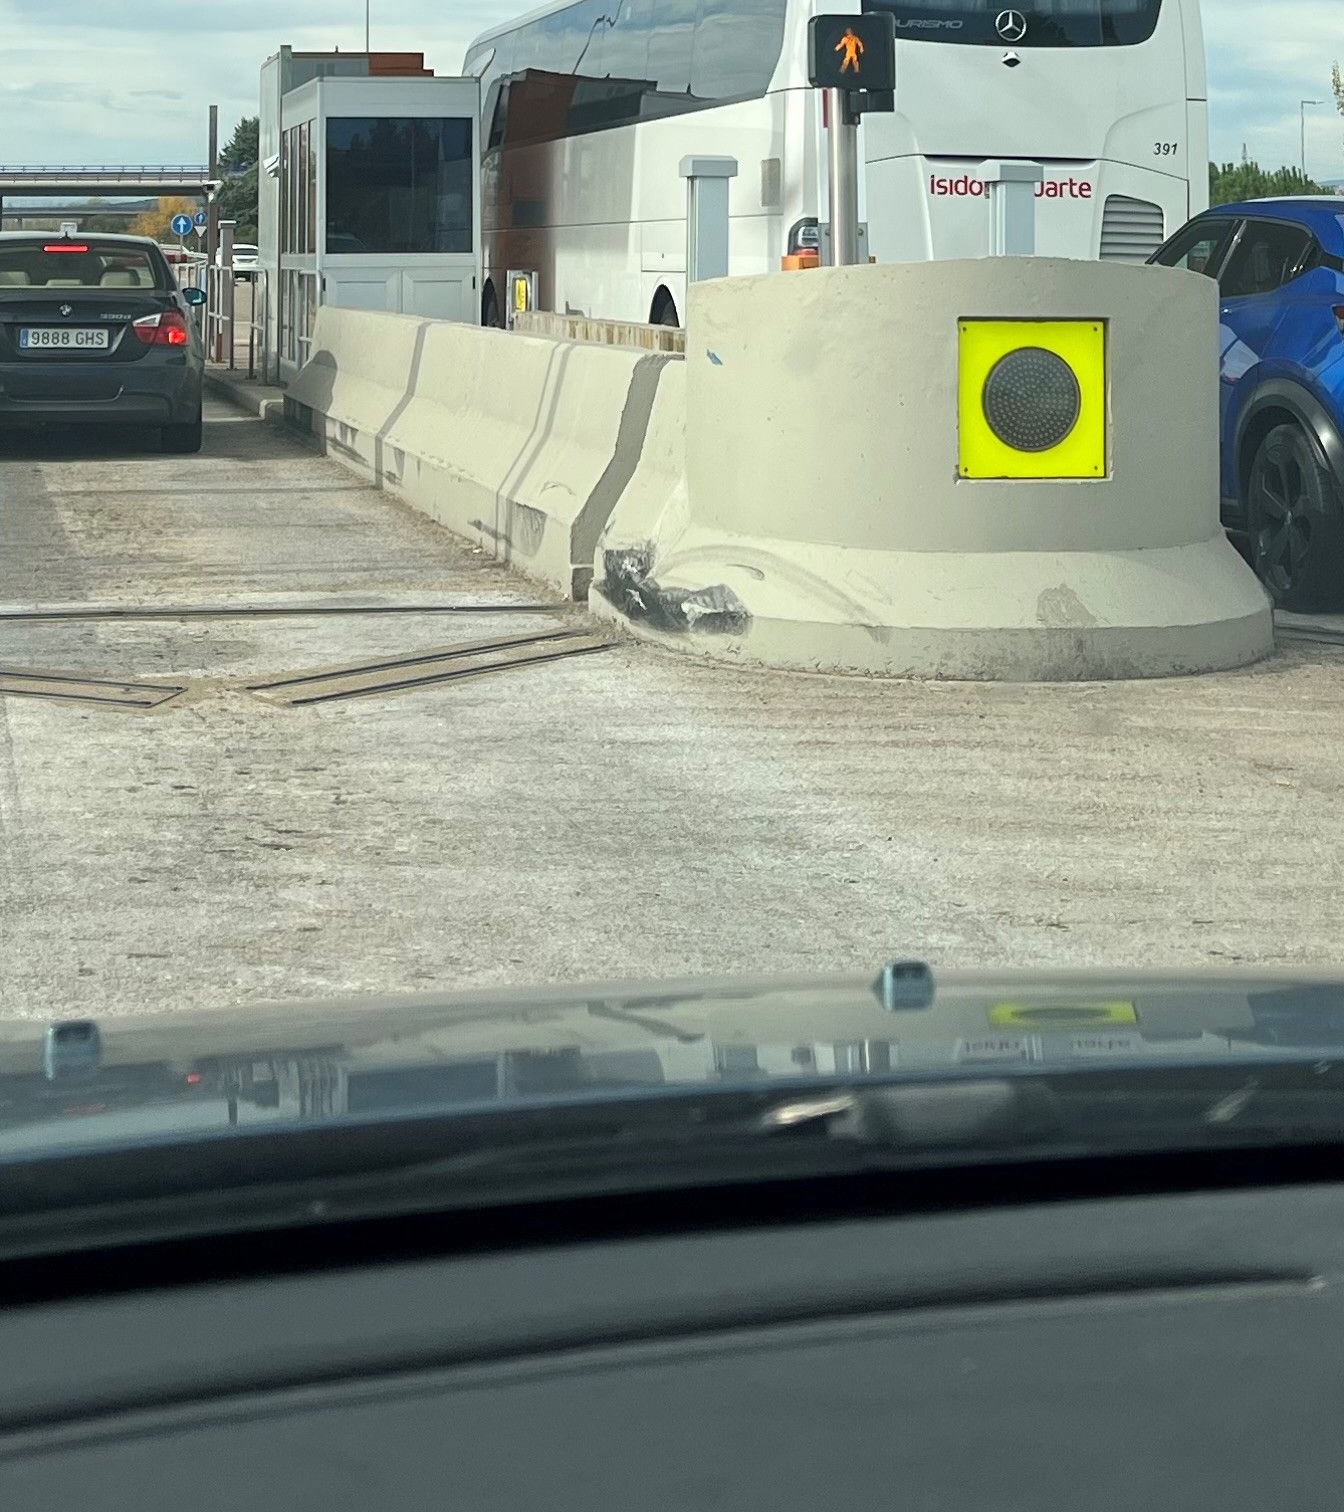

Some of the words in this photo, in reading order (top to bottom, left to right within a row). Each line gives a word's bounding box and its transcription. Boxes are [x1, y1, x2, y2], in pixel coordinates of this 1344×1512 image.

[895, 18, 964, 29] URISMO
[1152, 141, 1179, 156] 391
[31, 331, 70, 346] 9888
[75, 331, 105, 346] GHS
